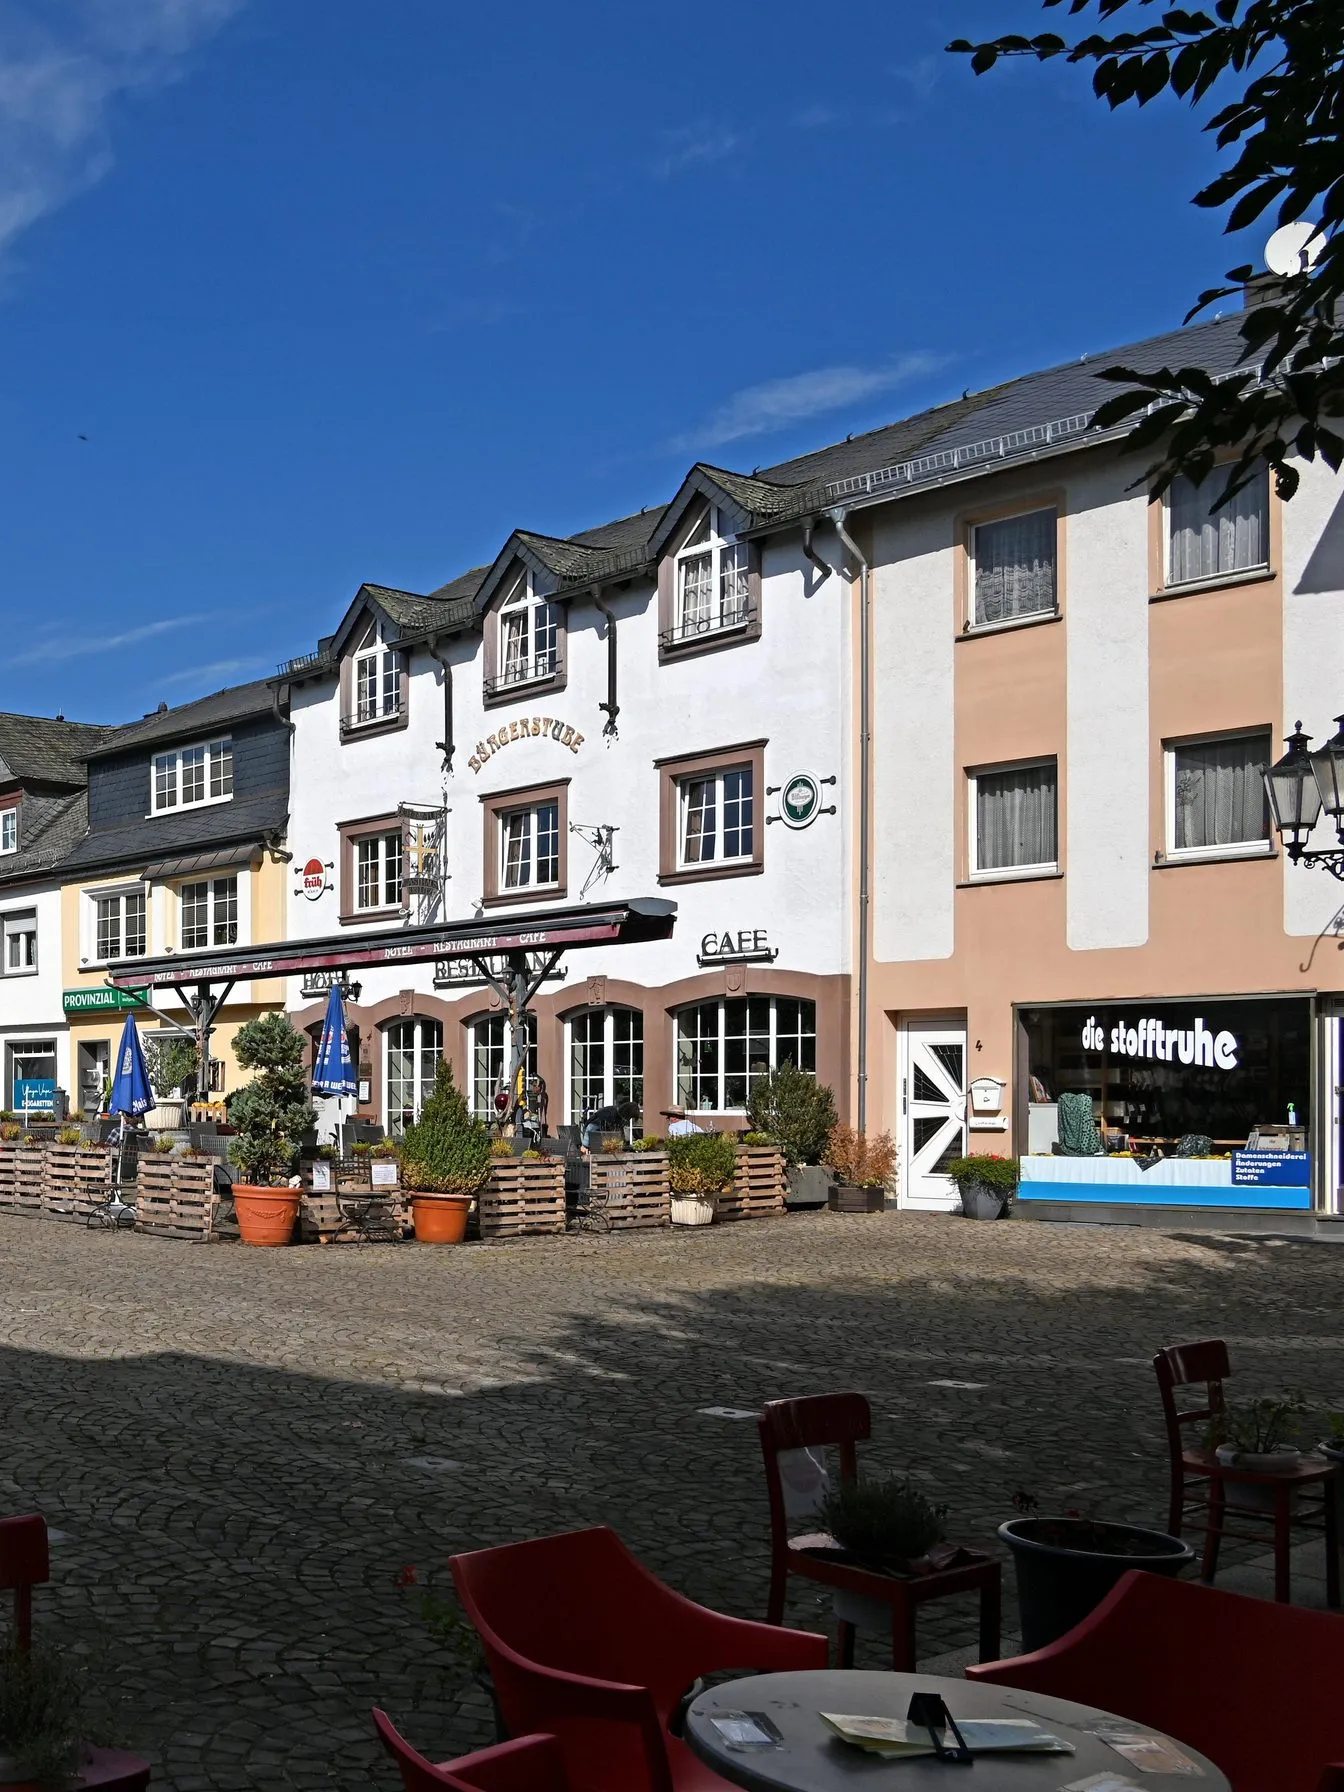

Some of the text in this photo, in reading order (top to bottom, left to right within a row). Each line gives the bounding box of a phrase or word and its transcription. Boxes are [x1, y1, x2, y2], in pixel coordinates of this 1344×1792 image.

[467, 716, 586, 775] BÜRGERSTUBE
[303, 876, 323, 889] früh
[384, 946, 413, 960] HOTEL
[433, 937, 498, 953] RESTAURANT
[519, 932, 547, 944] CAFE
[701, 929, 768, 956] CAFE
[64, 992, 116, 1007] PROVINZIAL
[975, 1039, 983, 1052] 4
[1081, 1015, 1238, 1070] die stofftruhe
[1235, 1152, 1307, 1160] Damenschneiderei
[1235, 1159, 1282, 1168] Änderungen
